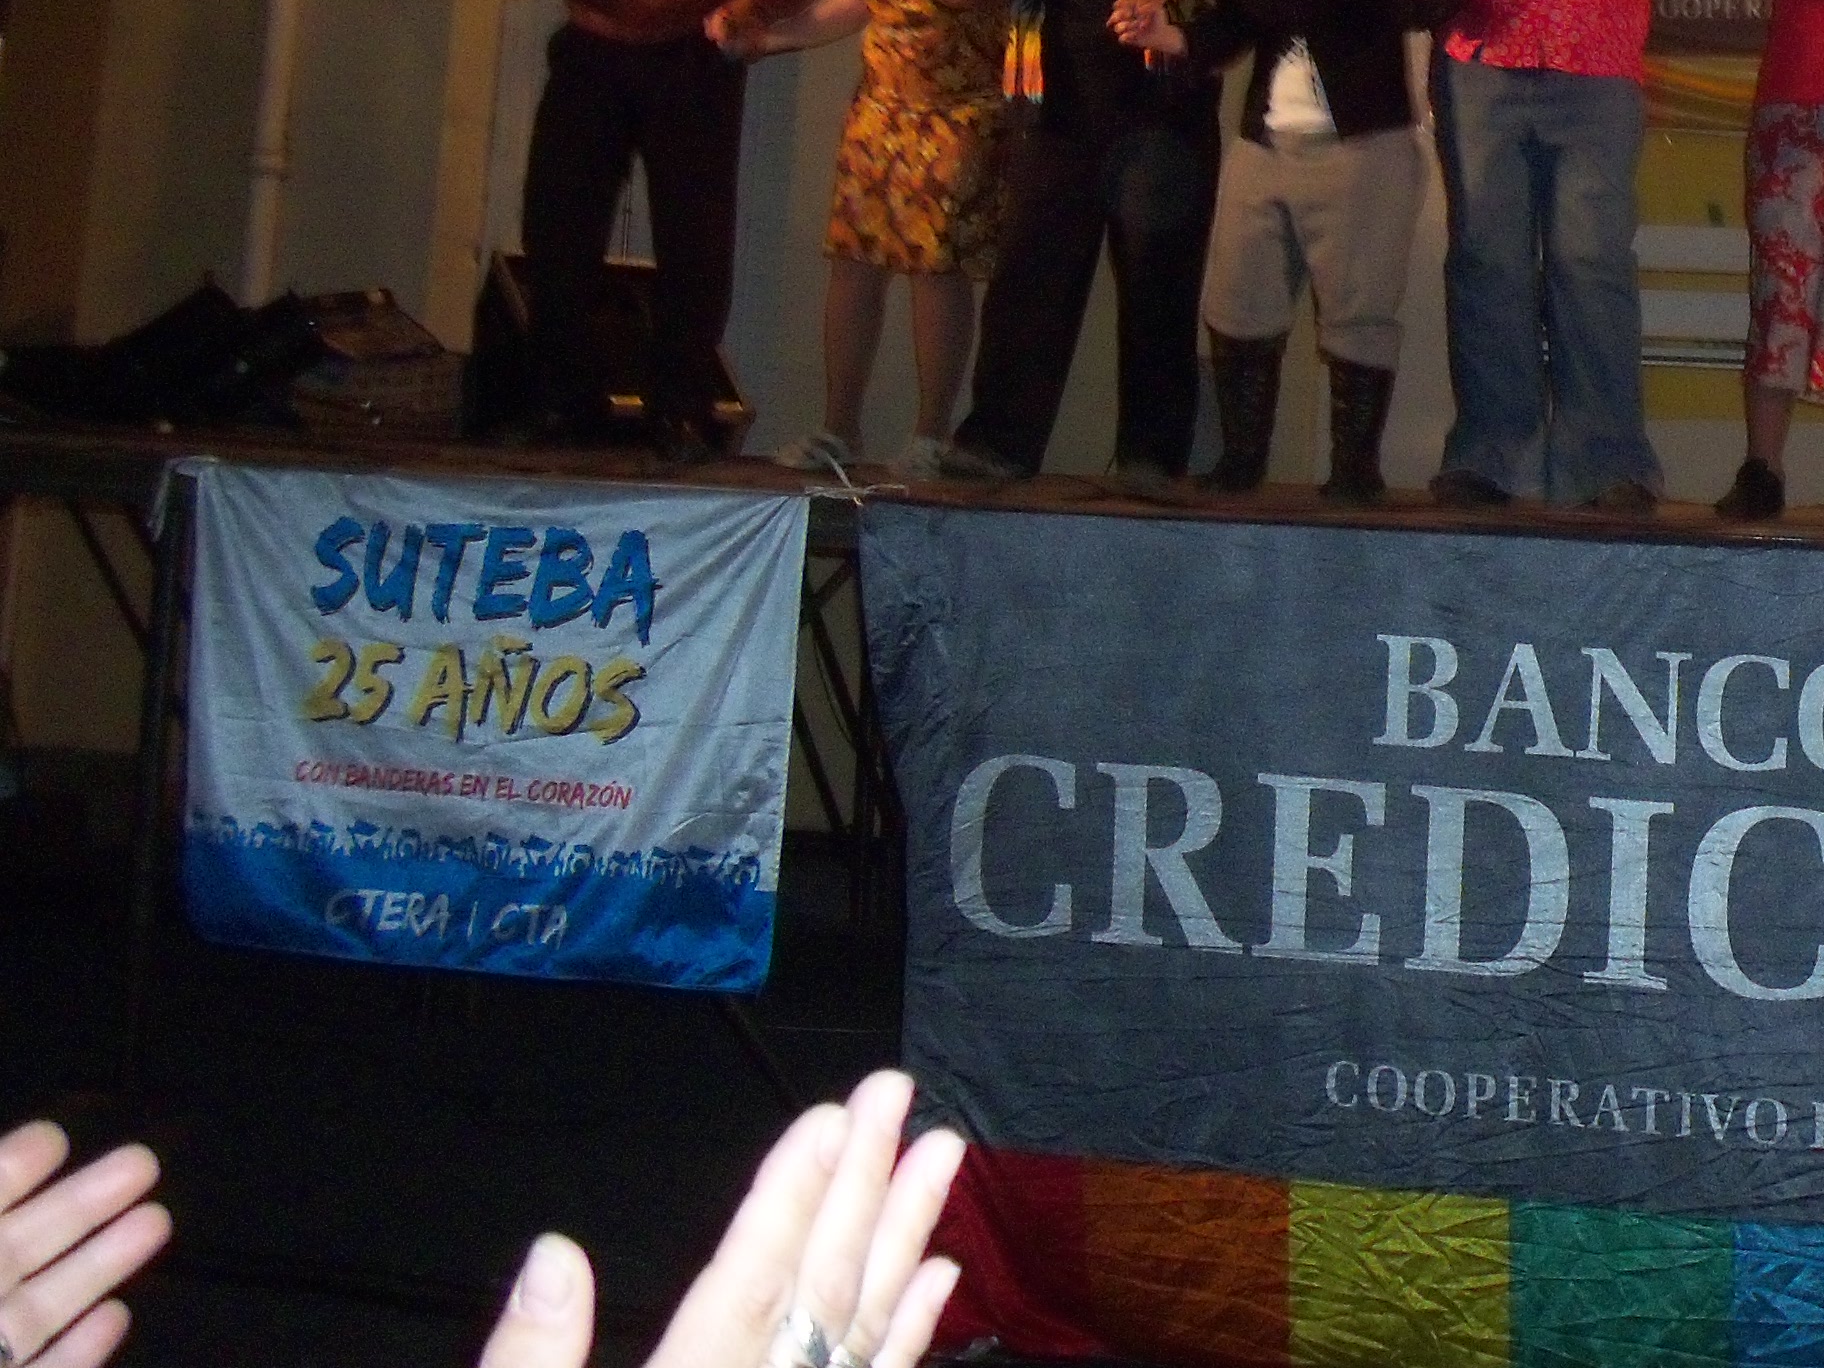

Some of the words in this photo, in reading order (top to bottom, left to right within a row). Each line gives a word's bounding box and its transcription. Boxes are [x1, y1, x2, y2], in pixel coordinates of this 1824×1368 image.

[310, 515, 663, 647] SUTEBA
[303, 636, 405, 726] 25
[409, 634, 648, 745] AÑOS
[295, 759, 342, 784] CON
[345, 763, 456, 797] BANDERAS
[459, 773, 490, 802] EN
[494, 775, 522, 800] EL
[526, 779, 634, 810] CORAZÓN
[325, 888, 451, 941] CTERA
[490, 902, 569, 951] CTA
[1325, 1059, 1789, 1146] COOPERATIVO
